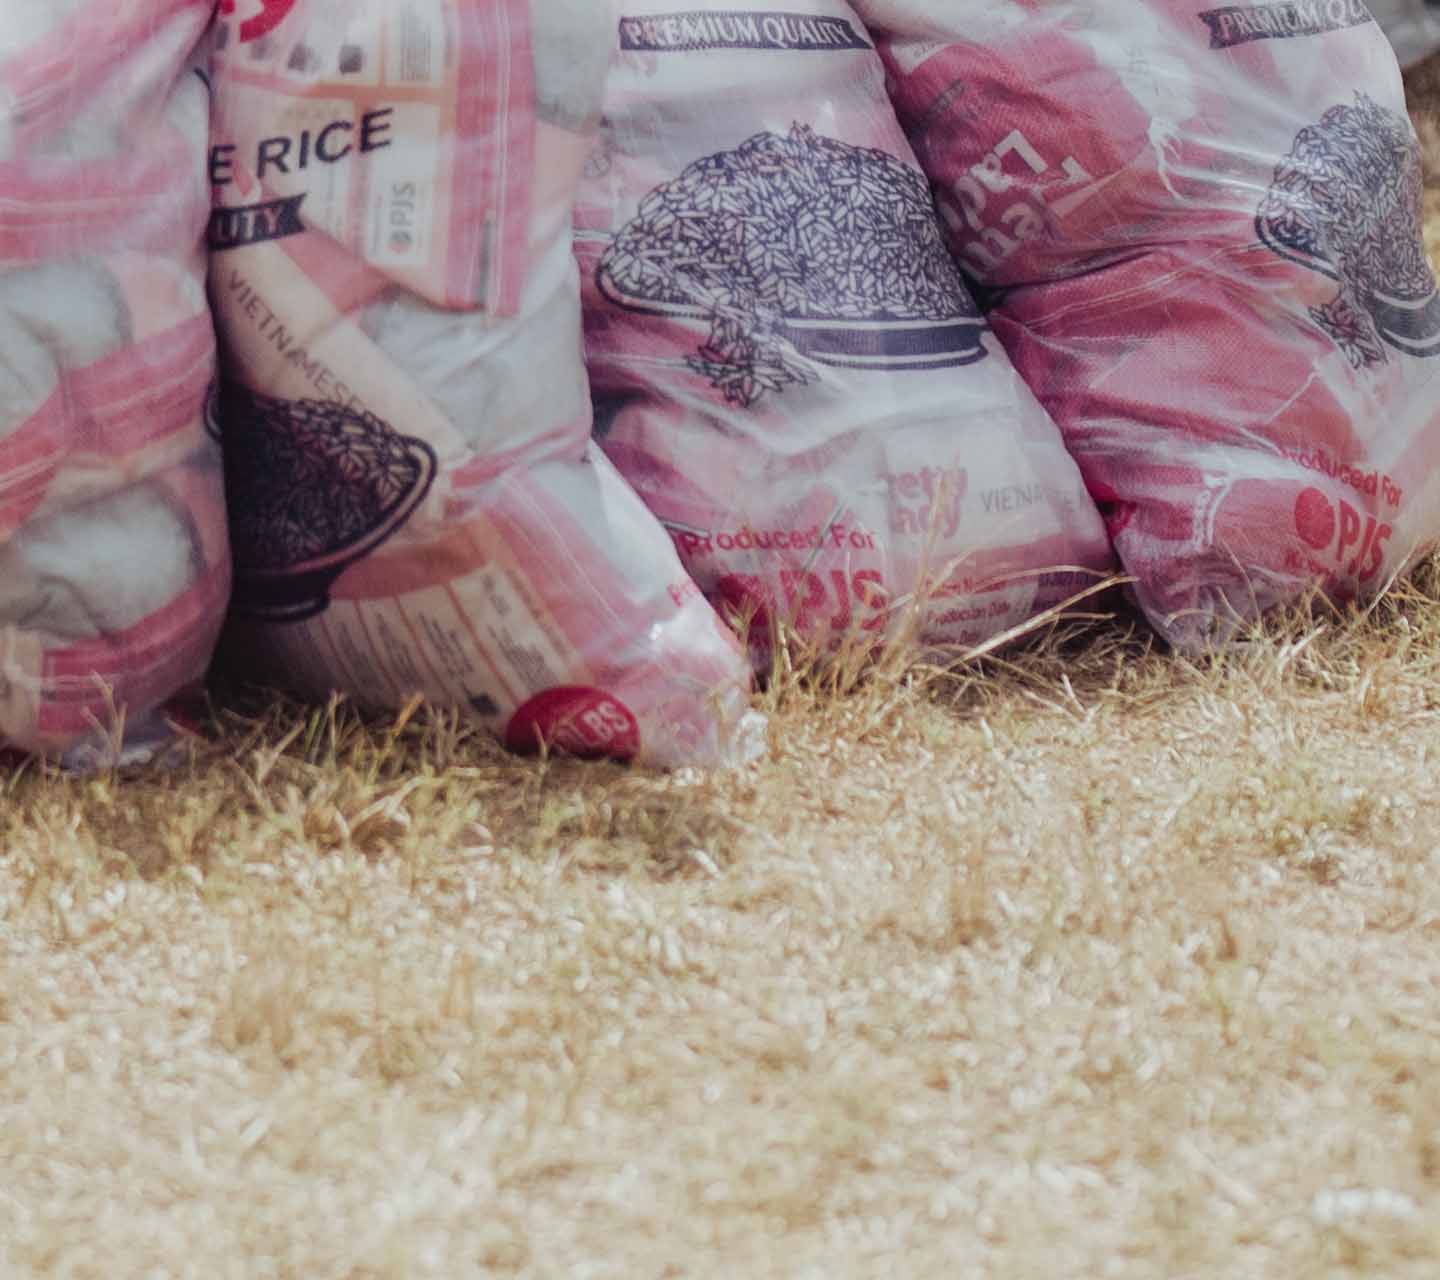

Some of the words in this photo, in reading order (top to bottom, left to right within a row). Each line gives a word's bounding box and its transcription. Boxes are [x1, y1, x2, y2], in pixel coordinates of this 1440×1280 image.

[631, 16, 762, 46] PREMIUM
[763, 16, 856, 48] QUALITY
[1221, 3, 1321, 38] PREMIUM
[256, 107, 394, 180] RICE
[830, 523, 876, 552] For
[1336, 496, 1394, 584] PJS
